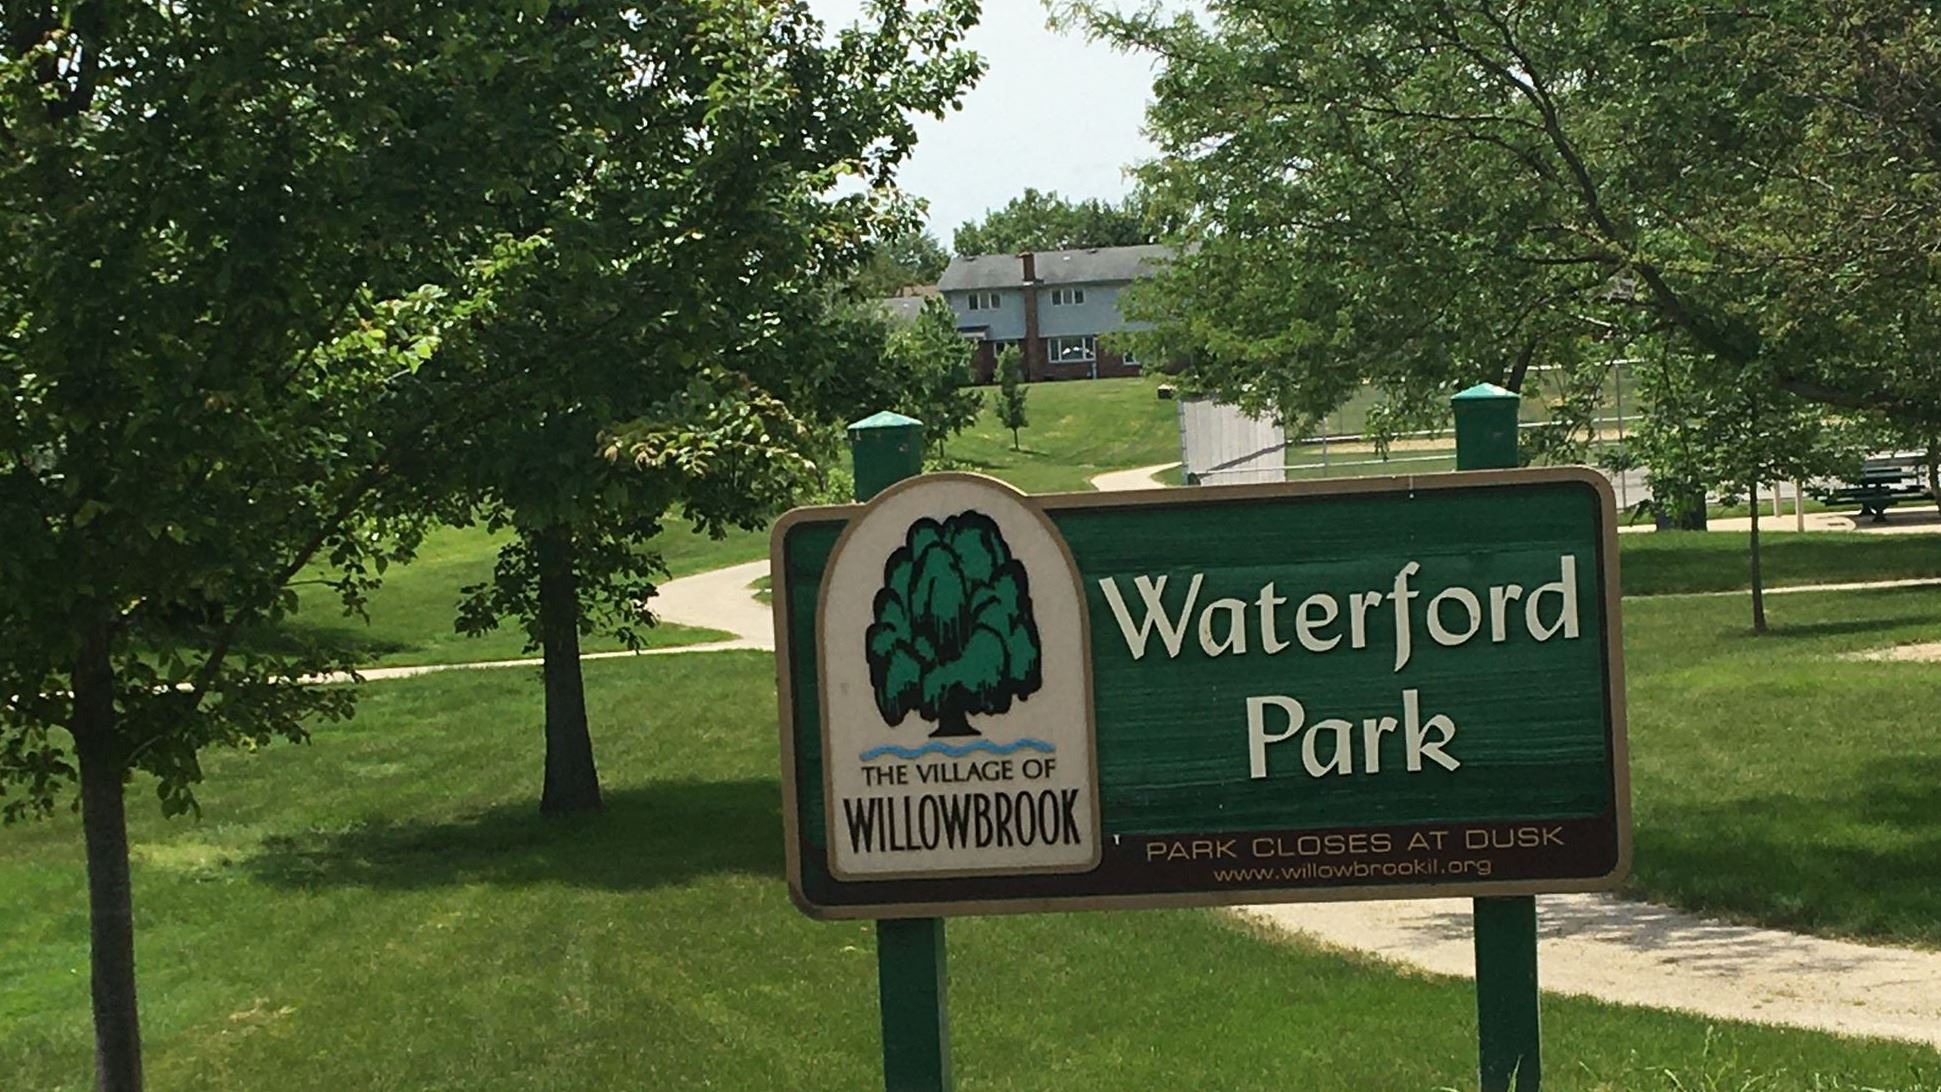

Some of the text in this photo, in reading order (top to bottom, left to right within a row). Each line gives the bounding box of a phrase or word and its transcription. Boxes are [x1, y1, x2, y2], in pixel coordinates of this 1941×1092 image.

[1098, 554, 1581, 672] Waterford
[1246, 689, 1462, 779] Park
[861, 758, 1056, 787] THE VILLAGE OF
[843, 788, 1081, 854] WILLOWBROOK
[1146, 826, 1565, 862] PARK CLOSES AT DUSK
[1213, 858, 1493, 884] www.willowbrookil.org
